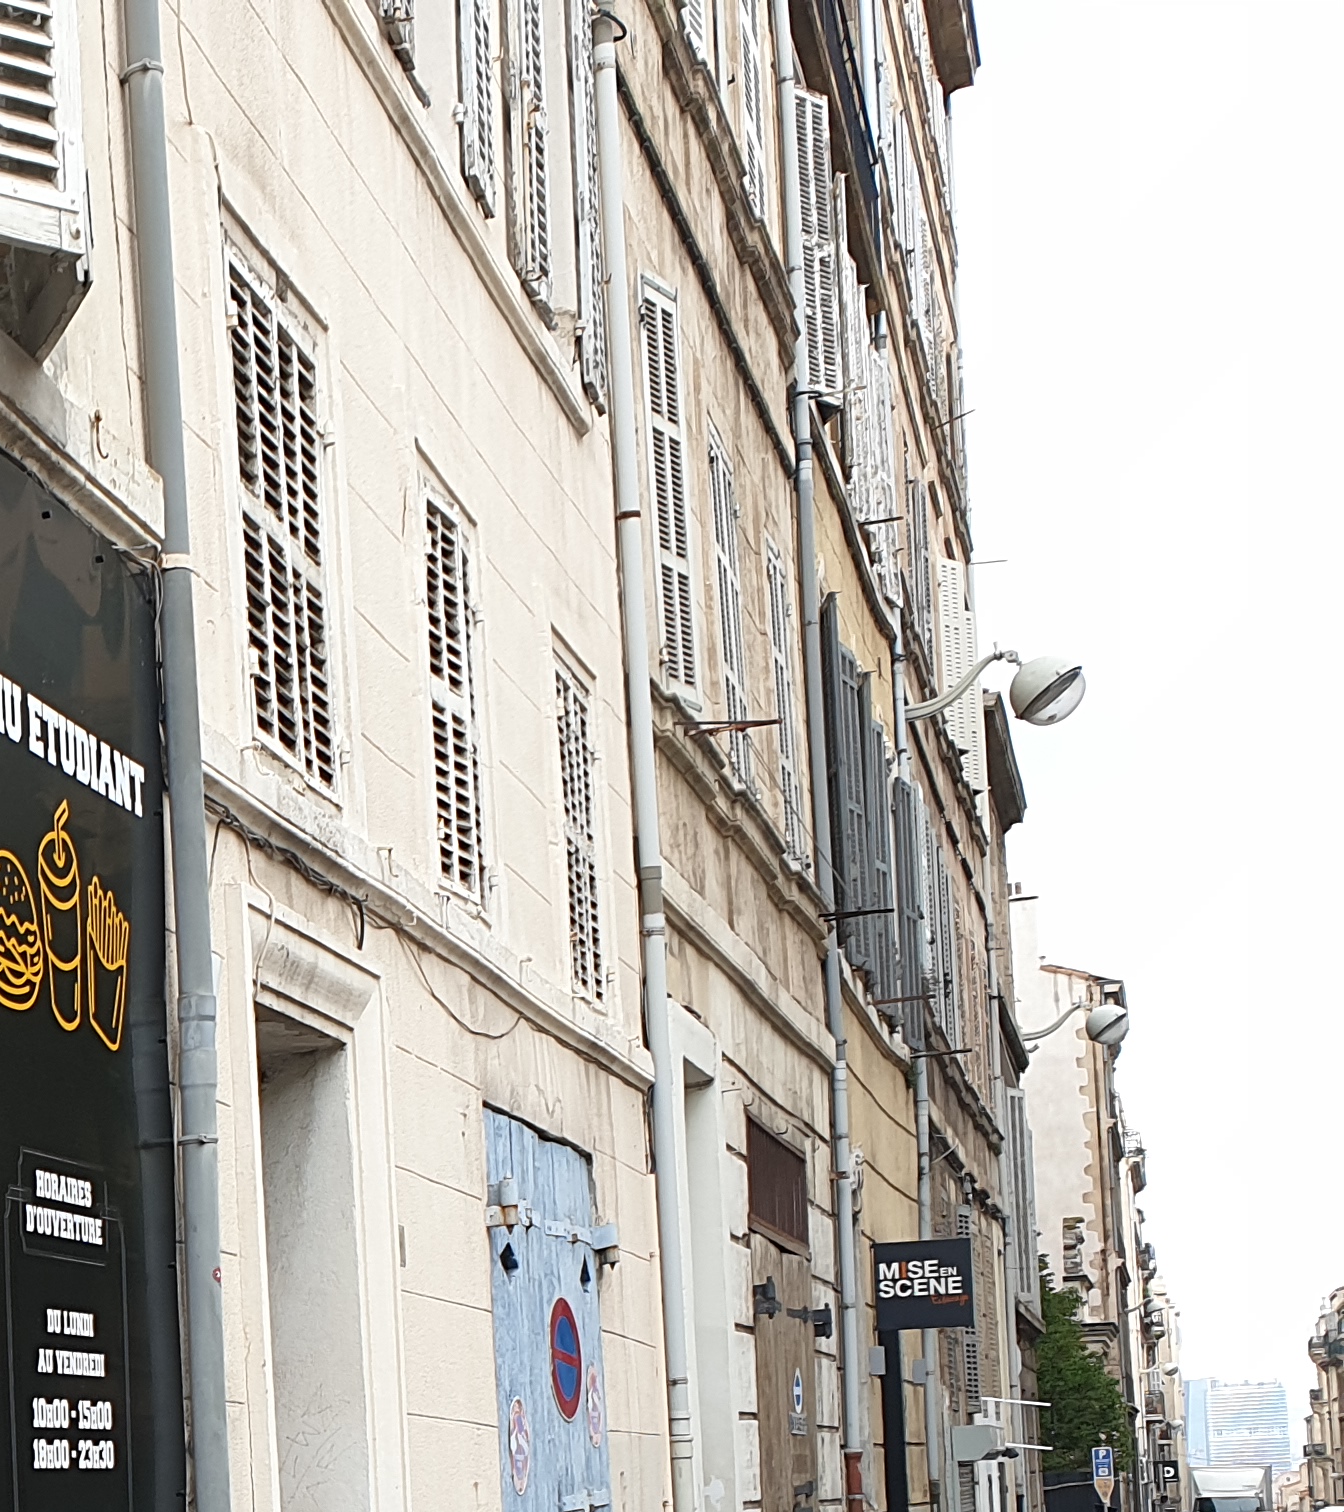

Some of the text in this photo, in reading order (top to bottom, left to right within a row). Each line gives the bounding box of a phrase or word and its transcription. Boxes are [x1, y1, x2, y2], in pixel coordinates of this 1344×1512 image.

[27, 693, 145, 818] ETUDIANT
[35, 1169, 92, 1208] HORAIRES
[25, 1203, 103, 1246] D'OUVERTURE
[878, 1260, 957, 1280] MISE EN
[878, 1276, 963, 1298] SCENE
[46, 1308, 95, 1338] DU LUNDI
[37, 1348, 105, 1378] AU VENDREDI
